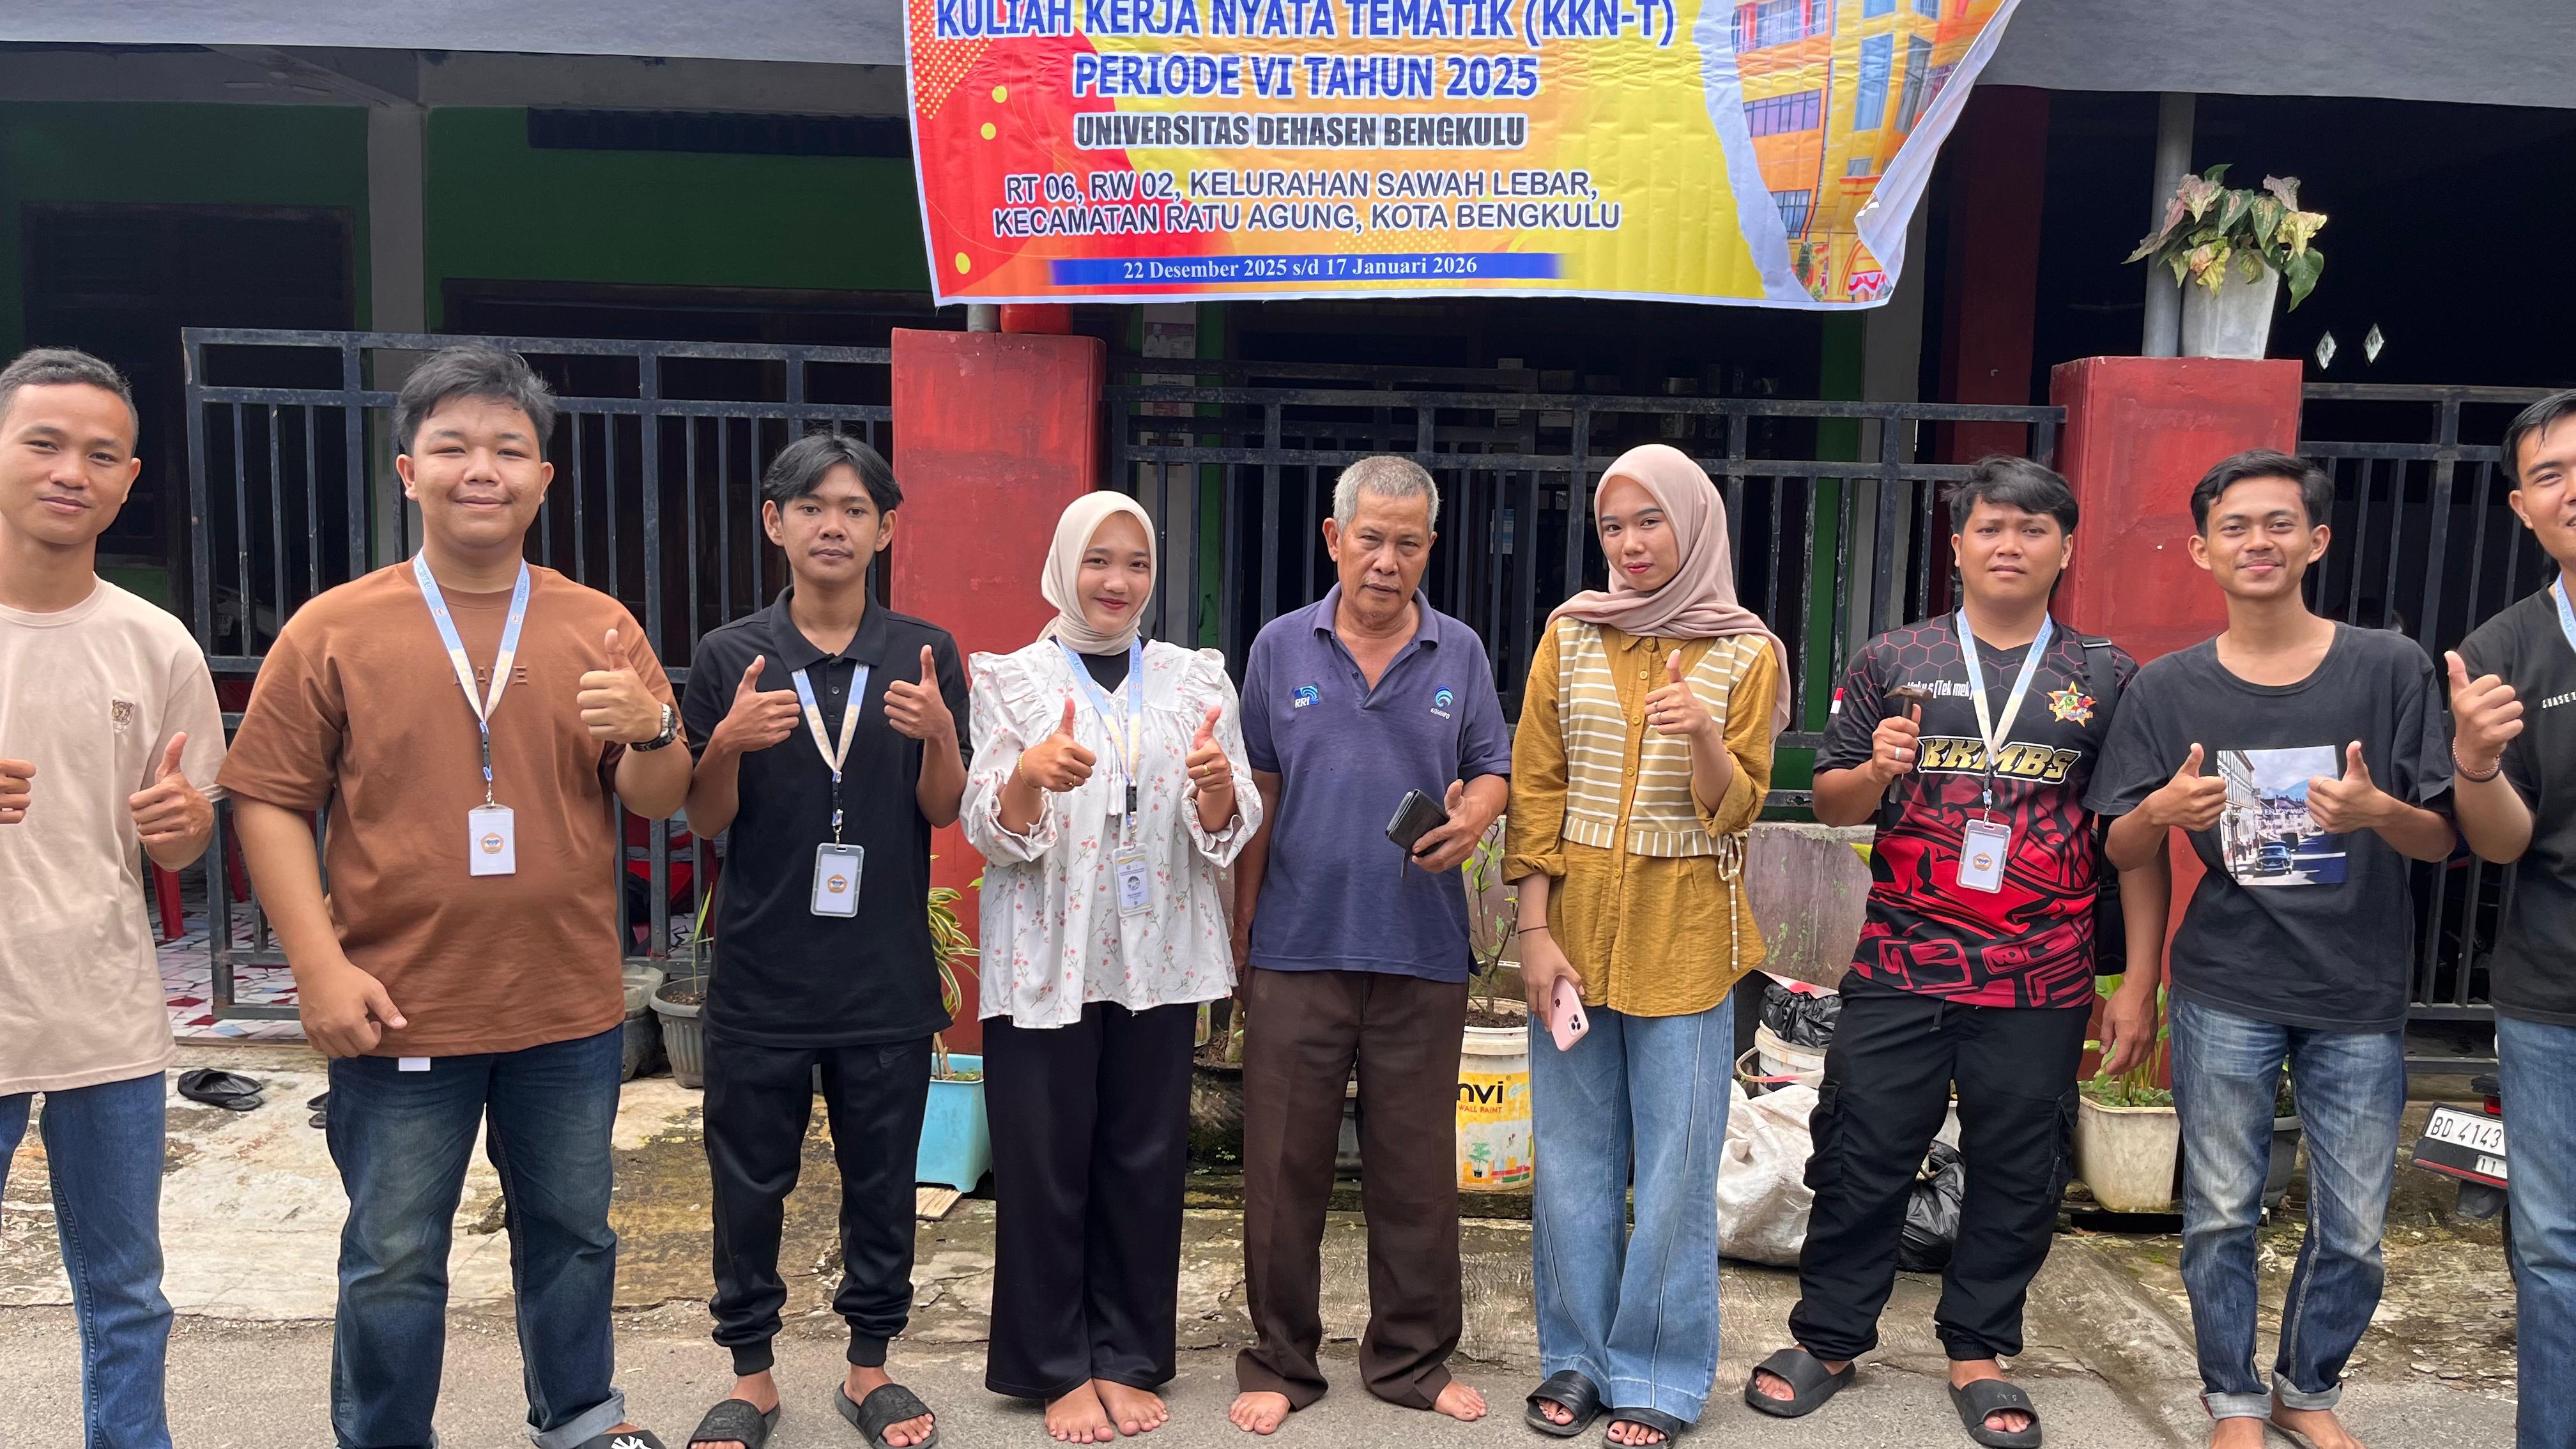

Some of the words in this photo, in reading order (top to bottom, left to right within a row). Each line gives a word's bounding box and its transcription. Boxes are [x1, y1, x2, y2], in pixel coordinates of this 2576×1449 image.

[937, 0, 1072, 36] KULIAH
[1085, 0, 1200, 34] KERJA
[1212, 0, 1335, 35] NYATA
[1345, 0, 1514, 36] TEMATIK
[1526, 0, 1675, 47] (KKN-T)
[1076, 56, 1239, 95] PERIODE
[1251, 57, 1294, 96] VI
[1304, 57, 1432, 96] TAHUN
[1447, 57, 1538, 96] 2025
[1078, 116, 1249, 146] UNIVERSITAS
[1258, 117, 1376, 146] DEHASEN
[1385, 118, 1524, 146] BENGKULU
[1007, 176, 1038, 201] RT
[1046, 175, 1082, 204] 06,
[1091, 174, 1135, 199] RW
[1142, 173, 1181, 202] 02,
[1191, 172, 1367, 197] KELURAHAN
[1378, 172, 1483, 196] SAWAH
[1496, 172, 1597, 200] LEBAR,
[996, 206, 1157, 235] KECAMATAN
[1167, 206, 1239, 230] RATU
[1248, 205, 1361, 233] AGUNG,
[1373, 206, 1446, 228] KOTA
[1459, 204, 1619, 227] BENGKULU
[1124, 262, 1144, 279] 22
[1149, 260, 1239, 278] Desember
[1244, 260, 1287, 277] 2025
[1292, 259, 1319, 277] s/d
[1326, 259, 1347, 276] 17
[1353, 257, 1427, 275] Januari
[1432, 257, 1478, 275] 2026
[1294, 696, 1310, 709] RRI
[1919, 737, 2080, 781] KKMBS
[1458, 1104, 1478, 1113] WALL
[2430, 1116, 2454, 1138] BD
[2457, 1122, 2503, 1149] 4143
